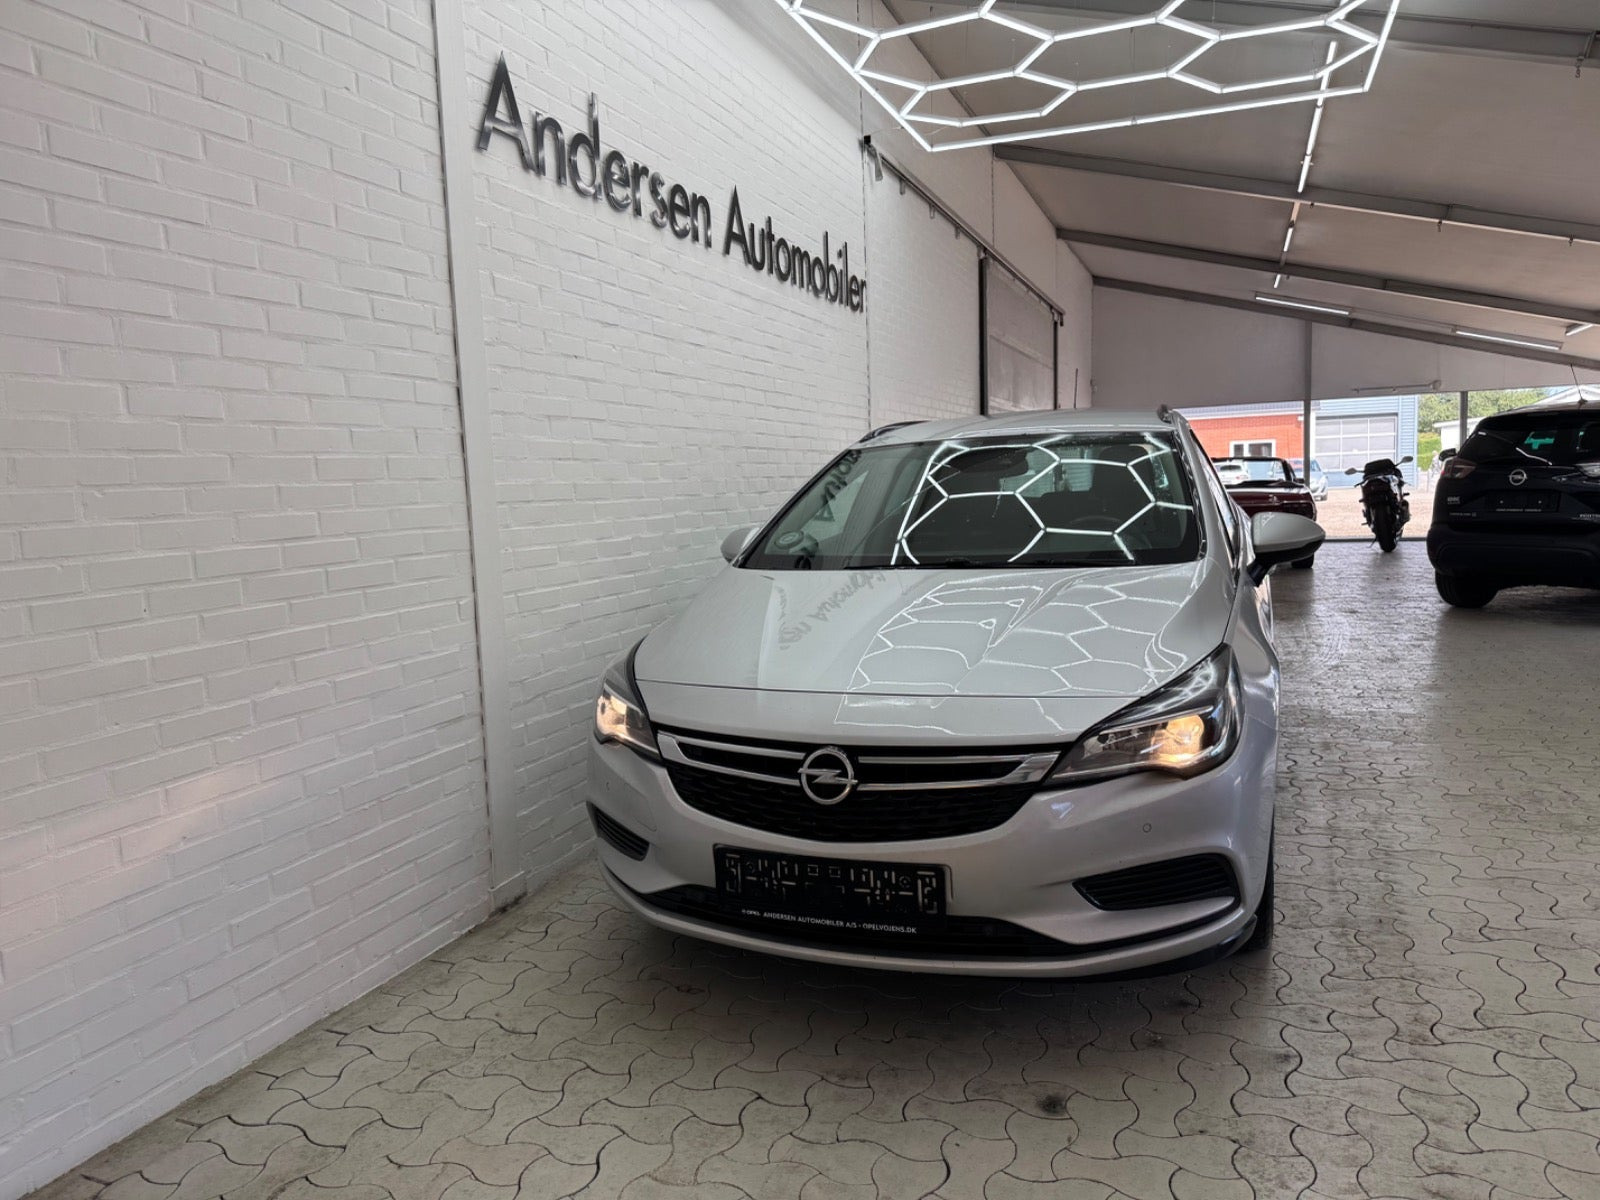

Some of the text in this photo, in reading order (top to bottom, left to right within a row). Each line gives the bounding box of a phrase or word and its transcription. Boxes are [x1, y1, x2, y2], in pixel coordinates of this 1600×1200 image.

[477, 50, 866, 312] Andersen Automobiler
[763, 911, 796, 921] ANDERSEN
[797, 916, 844, 927] AUTOMOBILER
[862, 922, 917, 934] OPELVOJENS.DK
